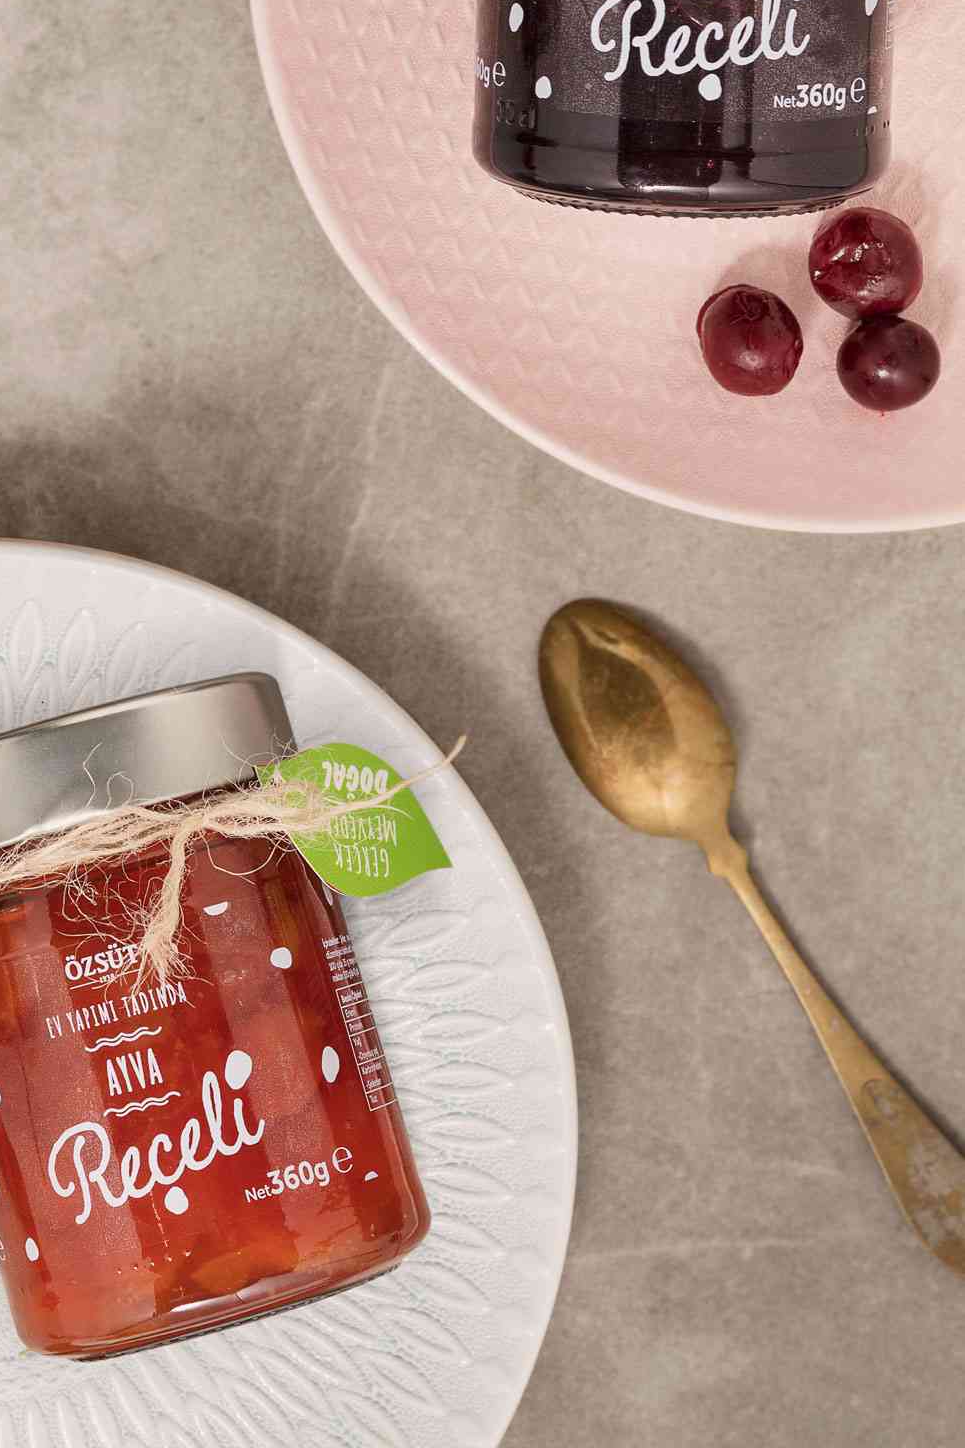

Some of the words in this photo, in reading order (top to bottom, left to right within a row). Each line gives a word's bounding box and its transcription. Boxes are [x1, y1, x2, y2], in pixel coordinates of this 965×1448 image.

[64, 943, 140, 981] ÖZSÜT
[46, 1015, 63, 1039] EV
[66, 1000, 119, 1033] YAPIMI
[121, 982, 187, 1018] TADINDA
[106, 1048, 163, 1097] AYVA
[48, 1050, 266, 1224] Reçeli
